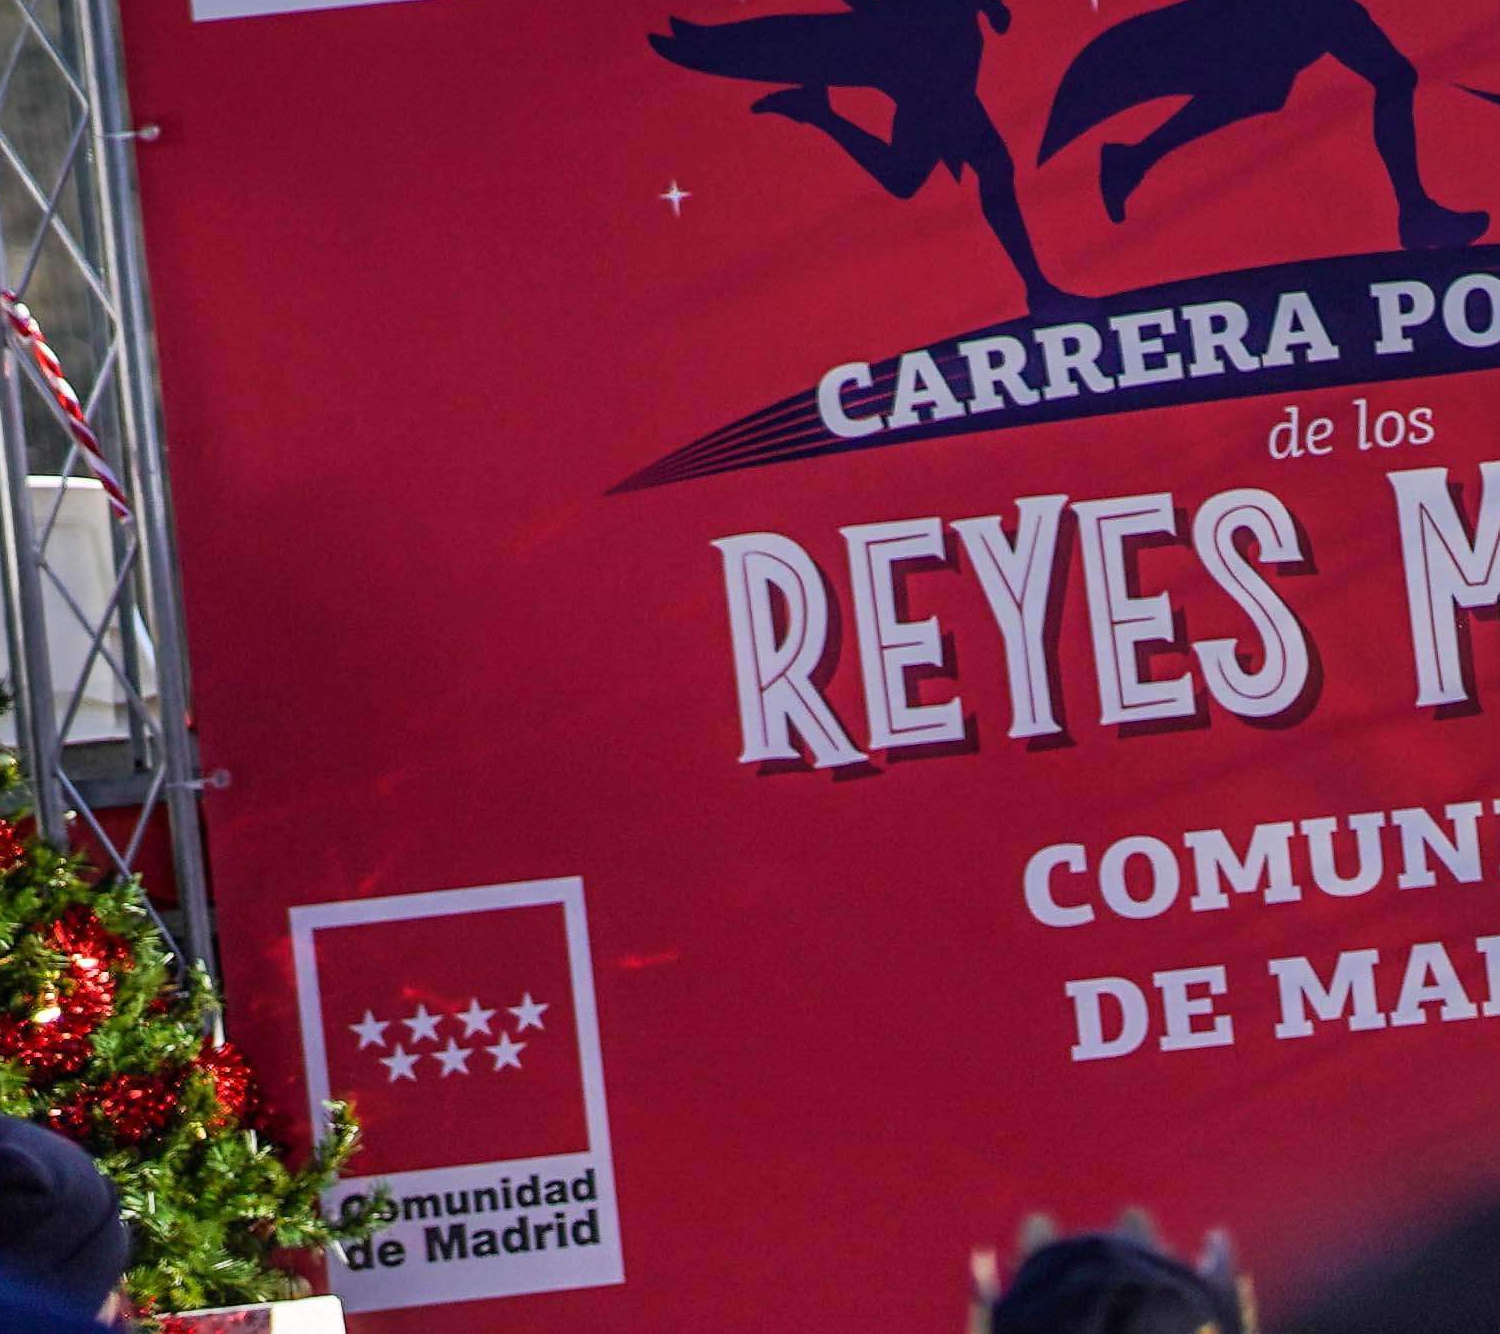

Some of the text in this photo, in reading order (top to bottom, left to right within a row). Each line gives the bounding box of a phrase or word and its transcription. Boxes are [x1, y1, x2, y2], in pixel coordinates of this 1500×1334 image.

[816, 289, 1341, 439] CARRERA
[1268, 398, 1435, 459] de los
[709, 487, 1312, 769] REYES
[1064, 965, 1234, 1062] DE
[339, 1168, 597, 1223] Comunidad
[347, 1209, 601, 1271] de Madrid
